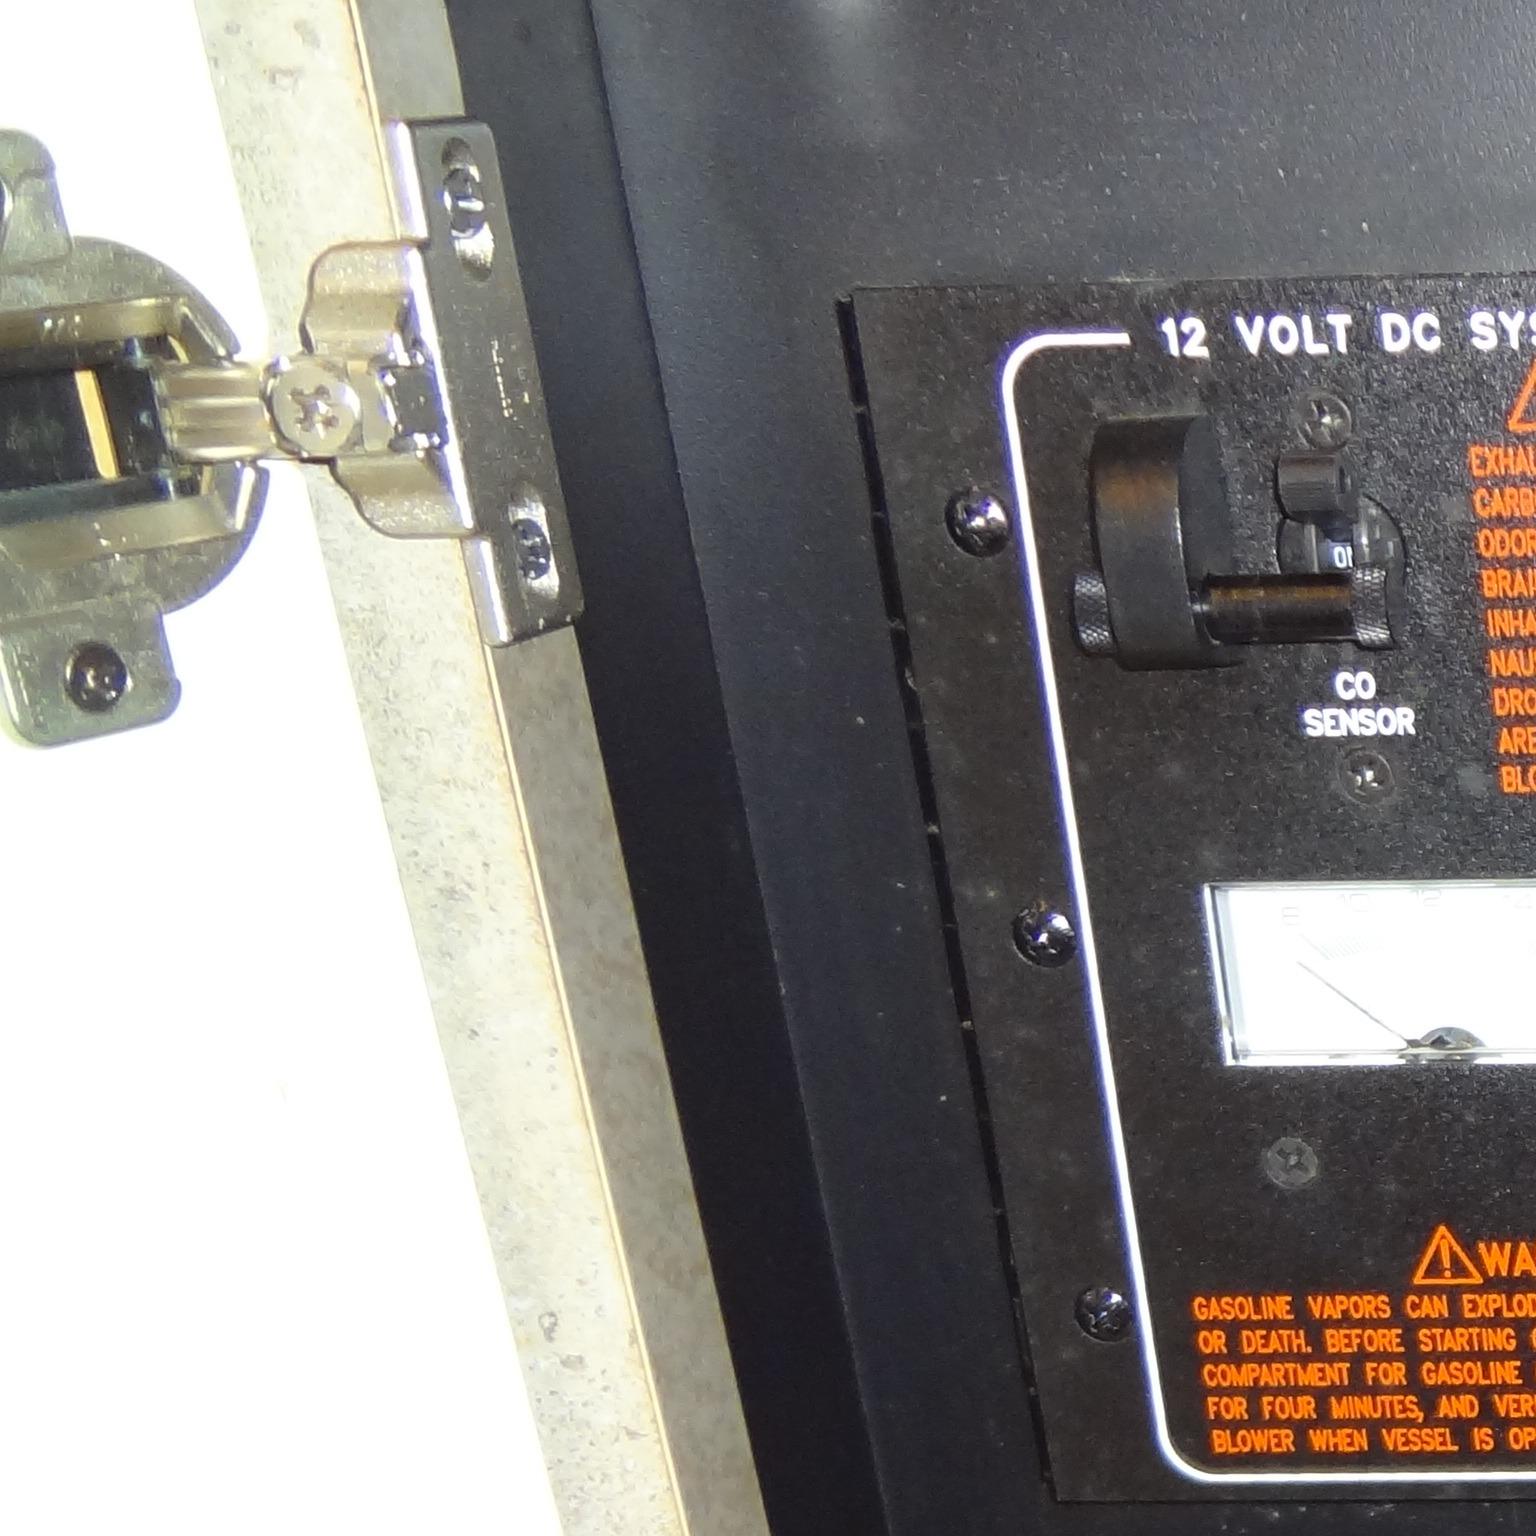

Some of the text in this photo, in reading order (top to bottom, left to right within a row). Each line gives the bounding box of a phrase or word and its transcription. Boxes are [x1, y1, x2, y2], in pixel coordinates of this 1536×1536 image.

[1161, 316, 1210, 359] 12
[1235, 313, 1353, 356] VOLT
[1379, 311, 1442, 354] DC
[1334, 670, 1377, 701] CO
[1303, 706, 1416, 737] SENSOR
[1191, 1294, 1293, 1322] GASOLINE
[1306, 1293, 1392, 1320] VAPORS
[1403, 1294, 1449, 1320] CAN
[1196, 1328, 1227, 1355] OR
[1239, 1327, 1312, 1356] DEATH.
[1322, 1327, 1404, 1355] BEFORE
[1416, 1326, 1518, 1353] STARTING
